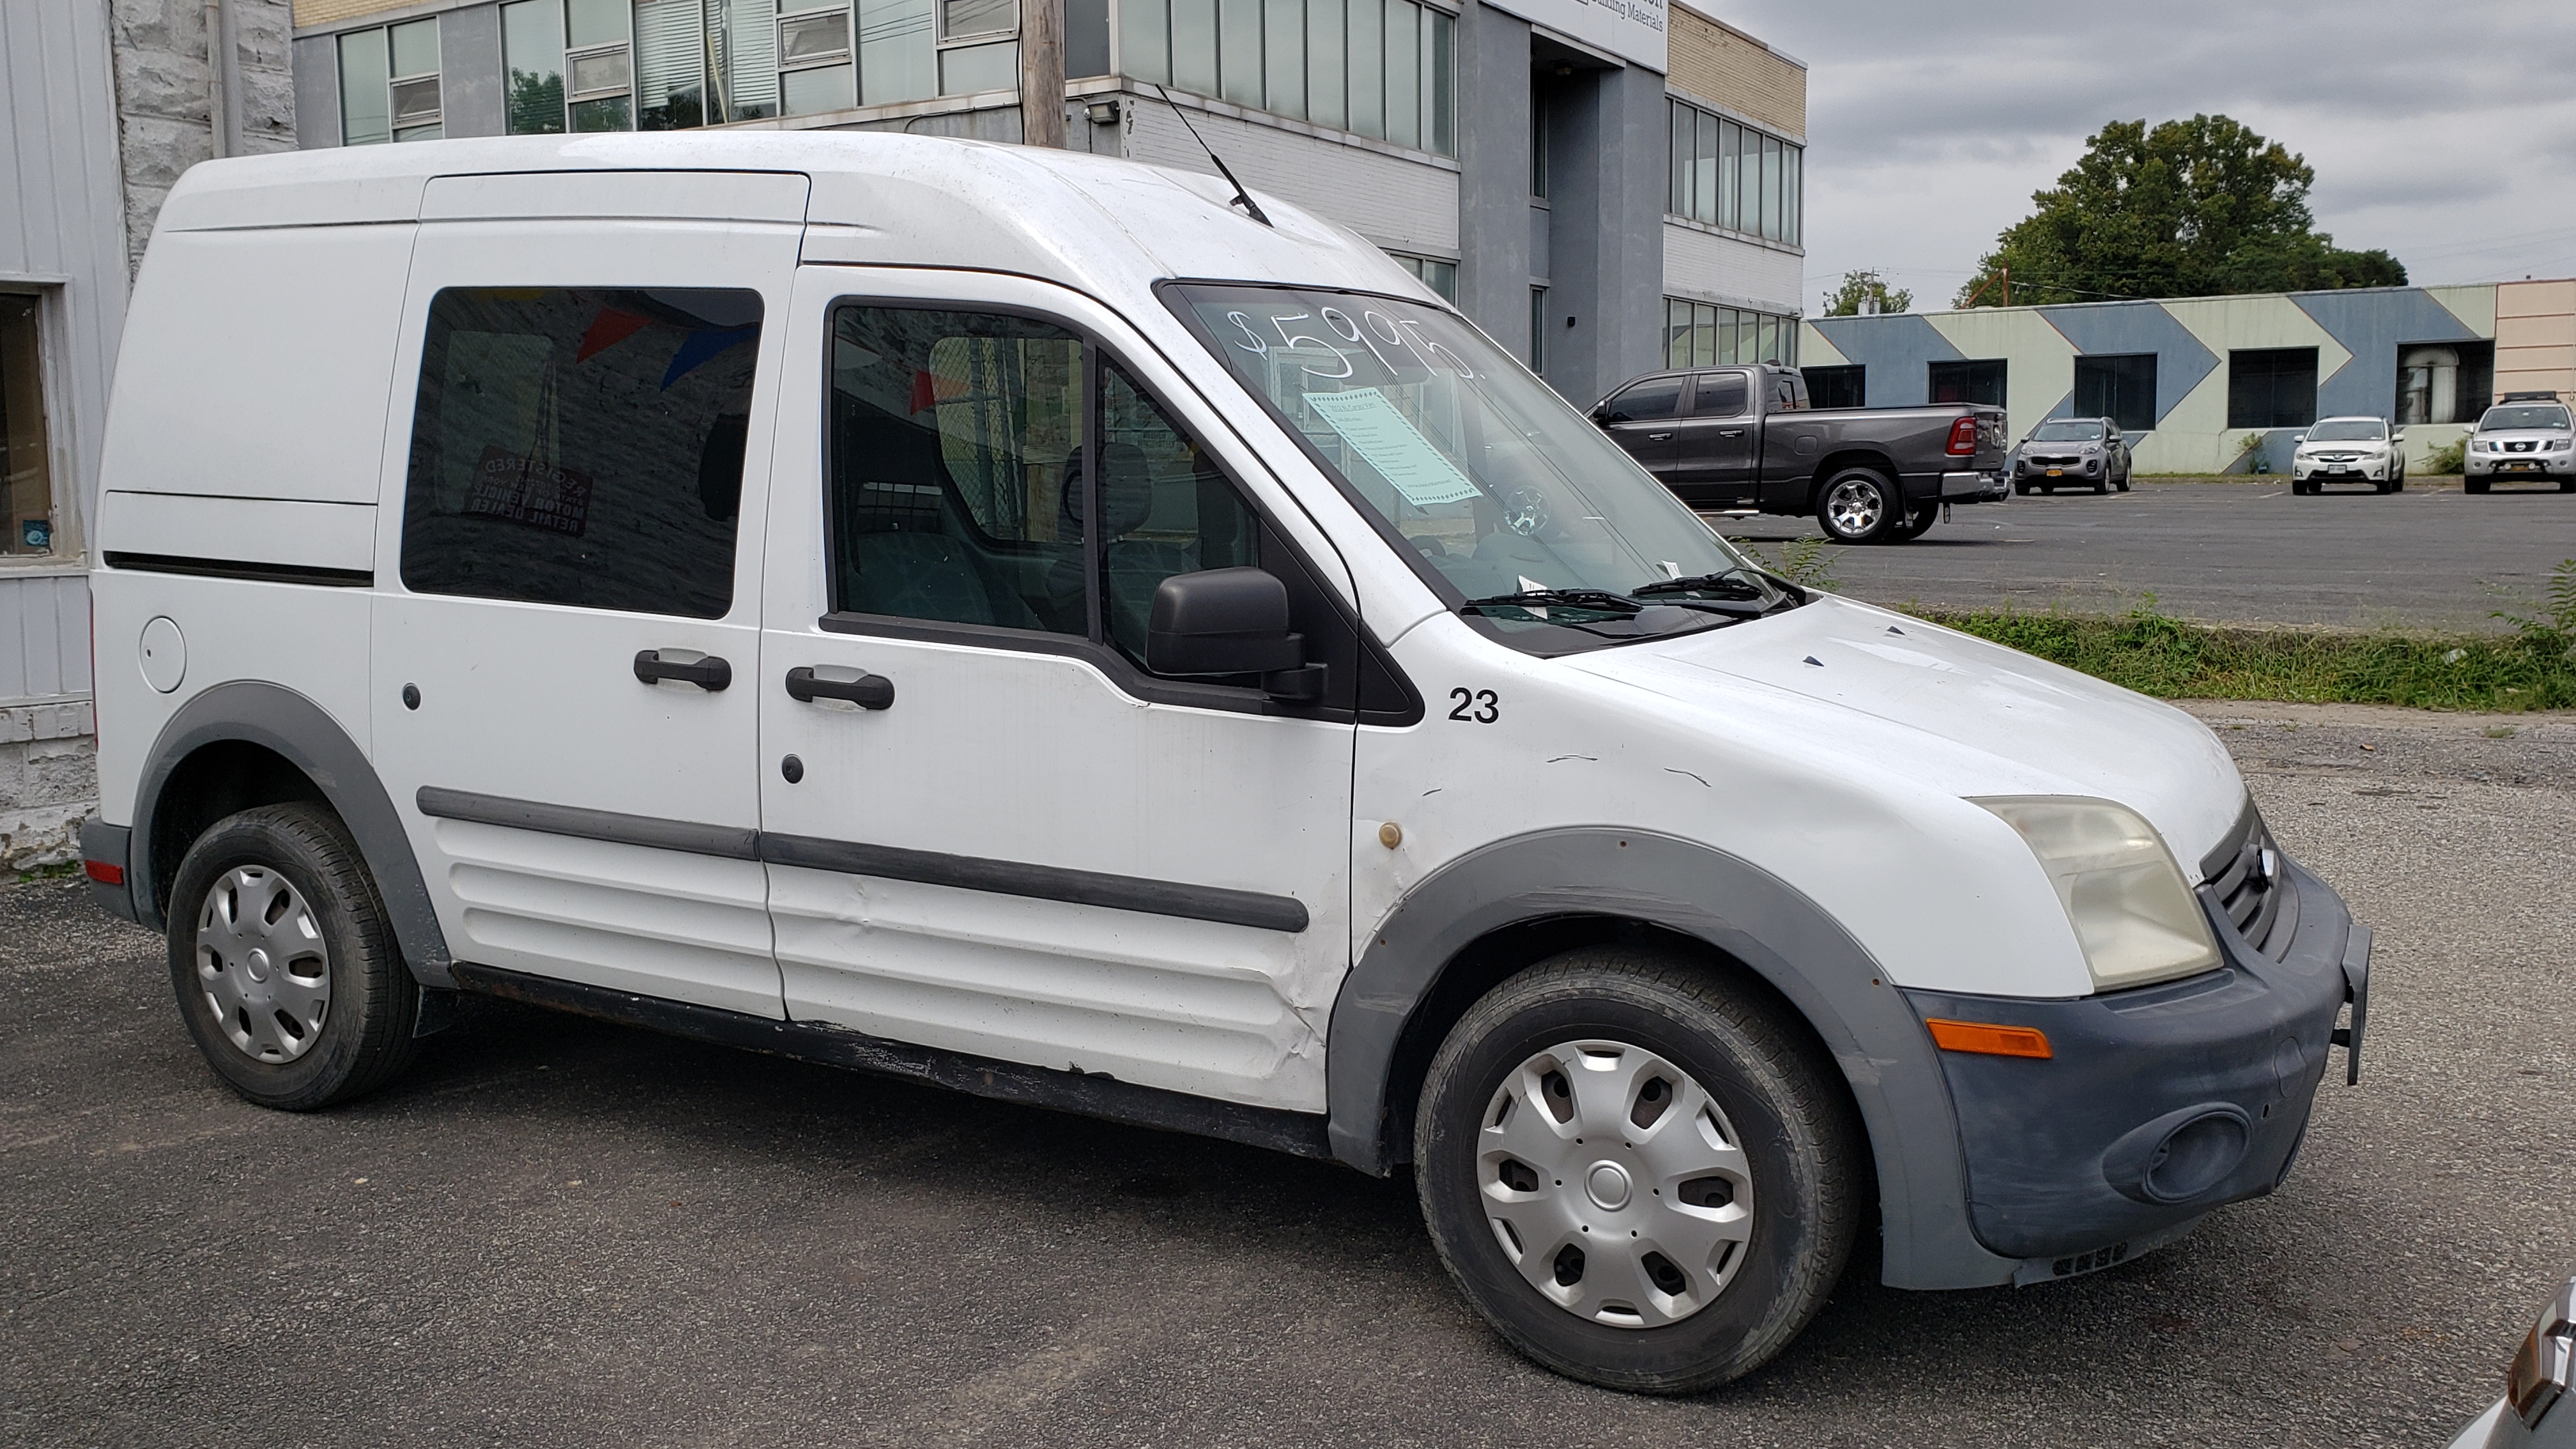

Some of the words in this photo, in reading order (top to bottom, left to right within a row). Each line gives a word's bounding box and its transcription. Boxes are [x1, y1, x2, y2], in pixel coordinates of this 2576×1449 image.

[1592, 0, 1625, 19] uilding
[1628, 2, 1663, 32] Materials
[1448, 687, 1499, 724] 23
